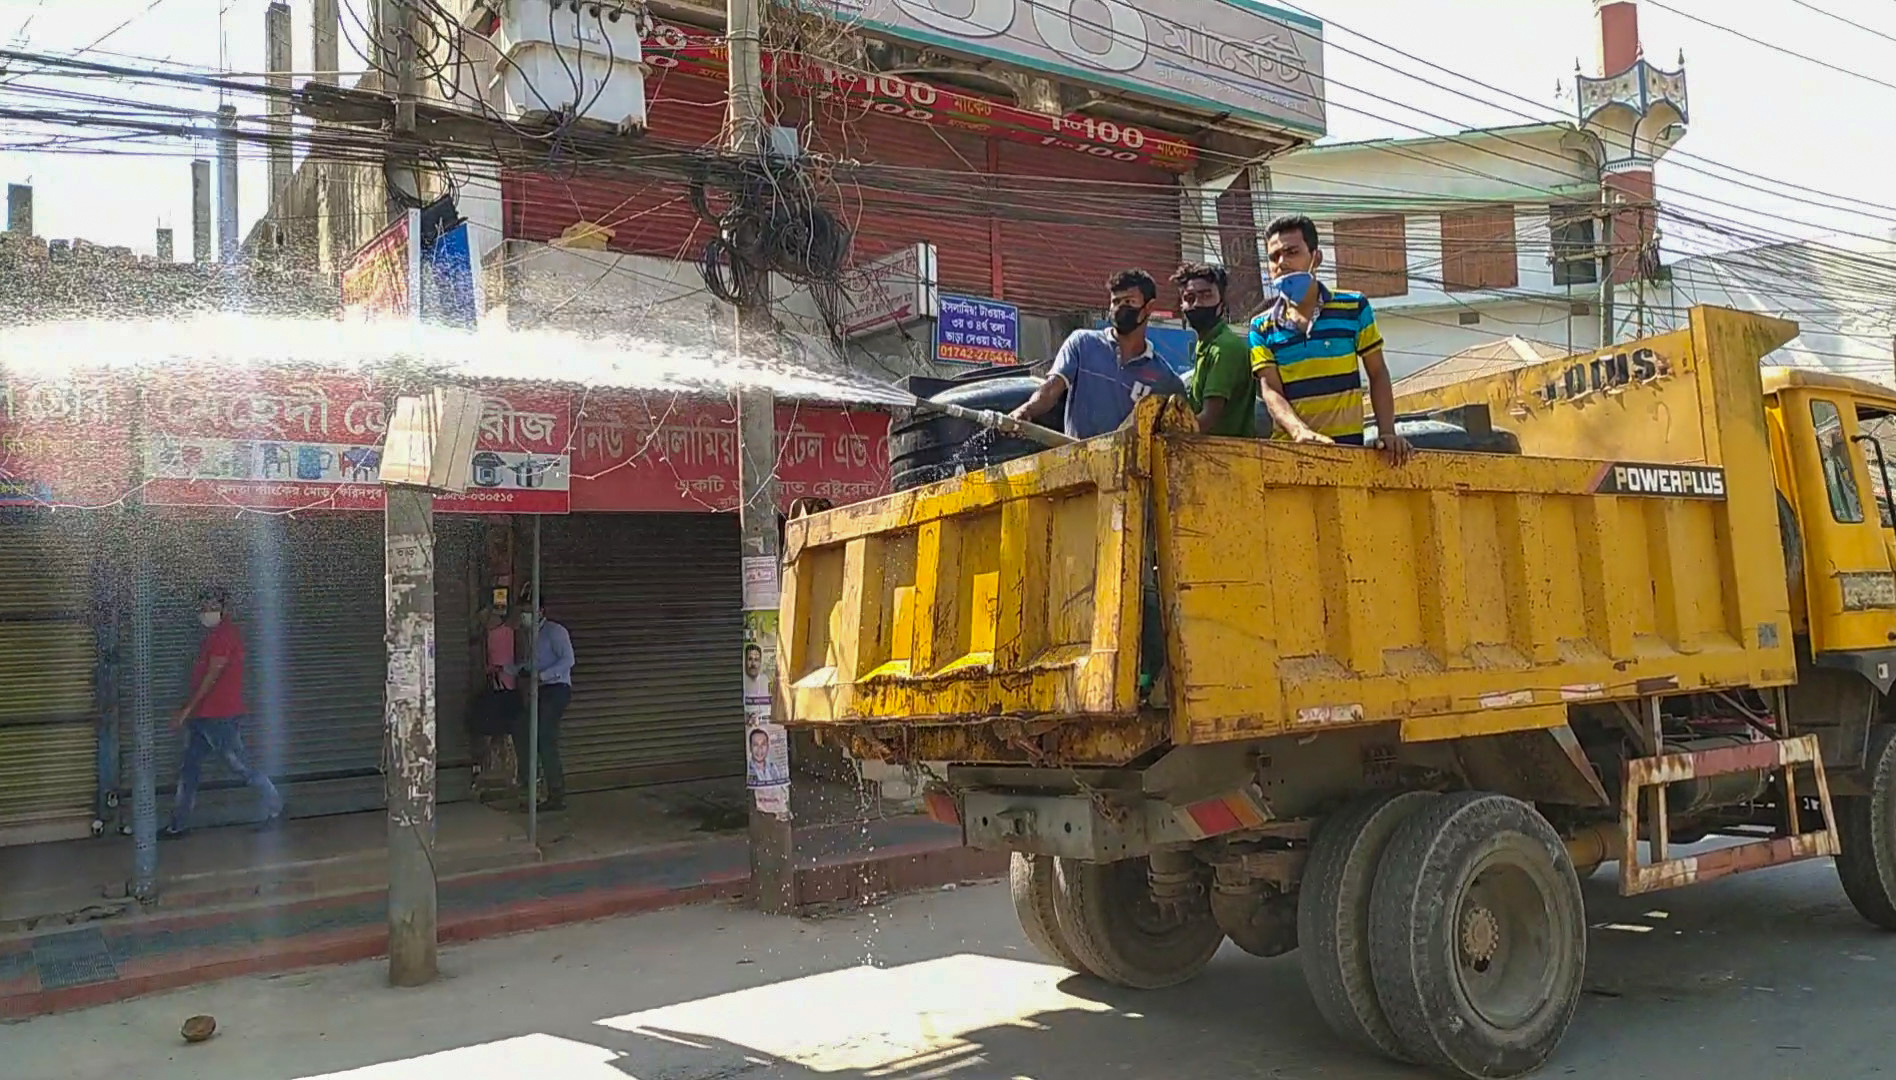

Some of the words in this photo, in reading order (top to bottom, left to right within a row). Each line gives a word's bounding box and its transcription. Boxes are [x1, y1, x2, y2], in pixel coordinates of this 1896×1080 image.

[1155, 20, 1306, 83] মার্কেট
[633, 415, 738, 469] ইসলামিয়
[1614, 466, 1724, 495] POWERPLUS
